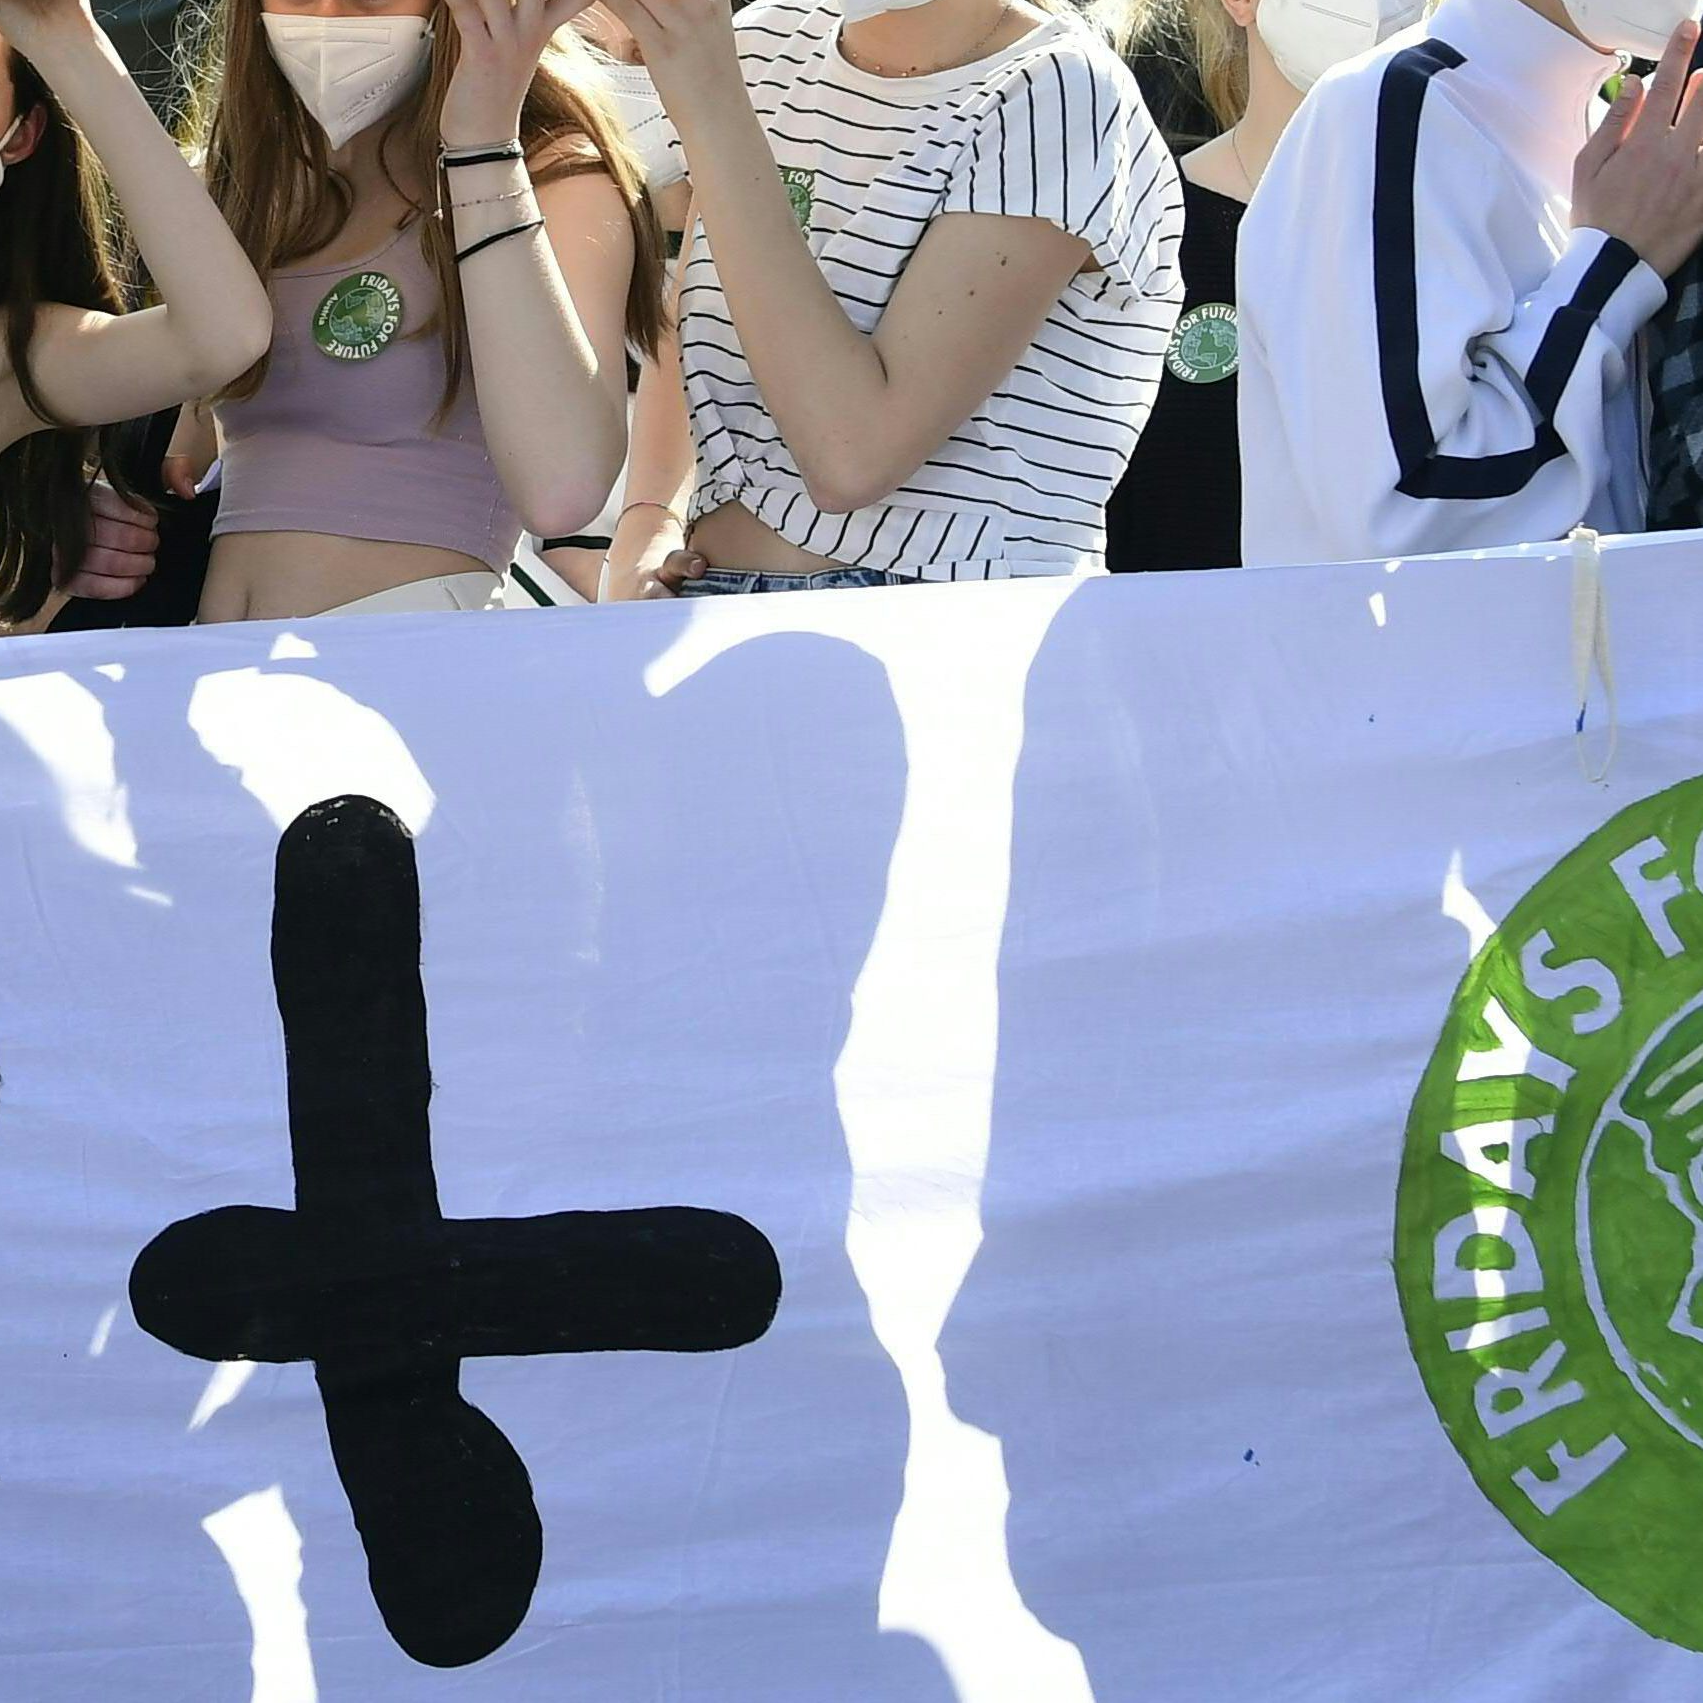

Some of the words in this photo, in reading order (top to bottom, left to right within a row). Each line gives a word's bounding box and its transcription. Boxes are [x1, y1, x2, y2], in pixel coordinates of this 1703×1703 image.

[360, 275, 400, 311] FRIDAYS
[376, 315, 398, 343] FOR
[1174, 313, 1200, 336] FOR
[326, 339, 378, 358] FUTURE
[1167, 338, 1198, 380] FRIDAYS
[1432, 928, 1629, 1517] FRIDAYS
[1608, 826, 1703, 959] F
